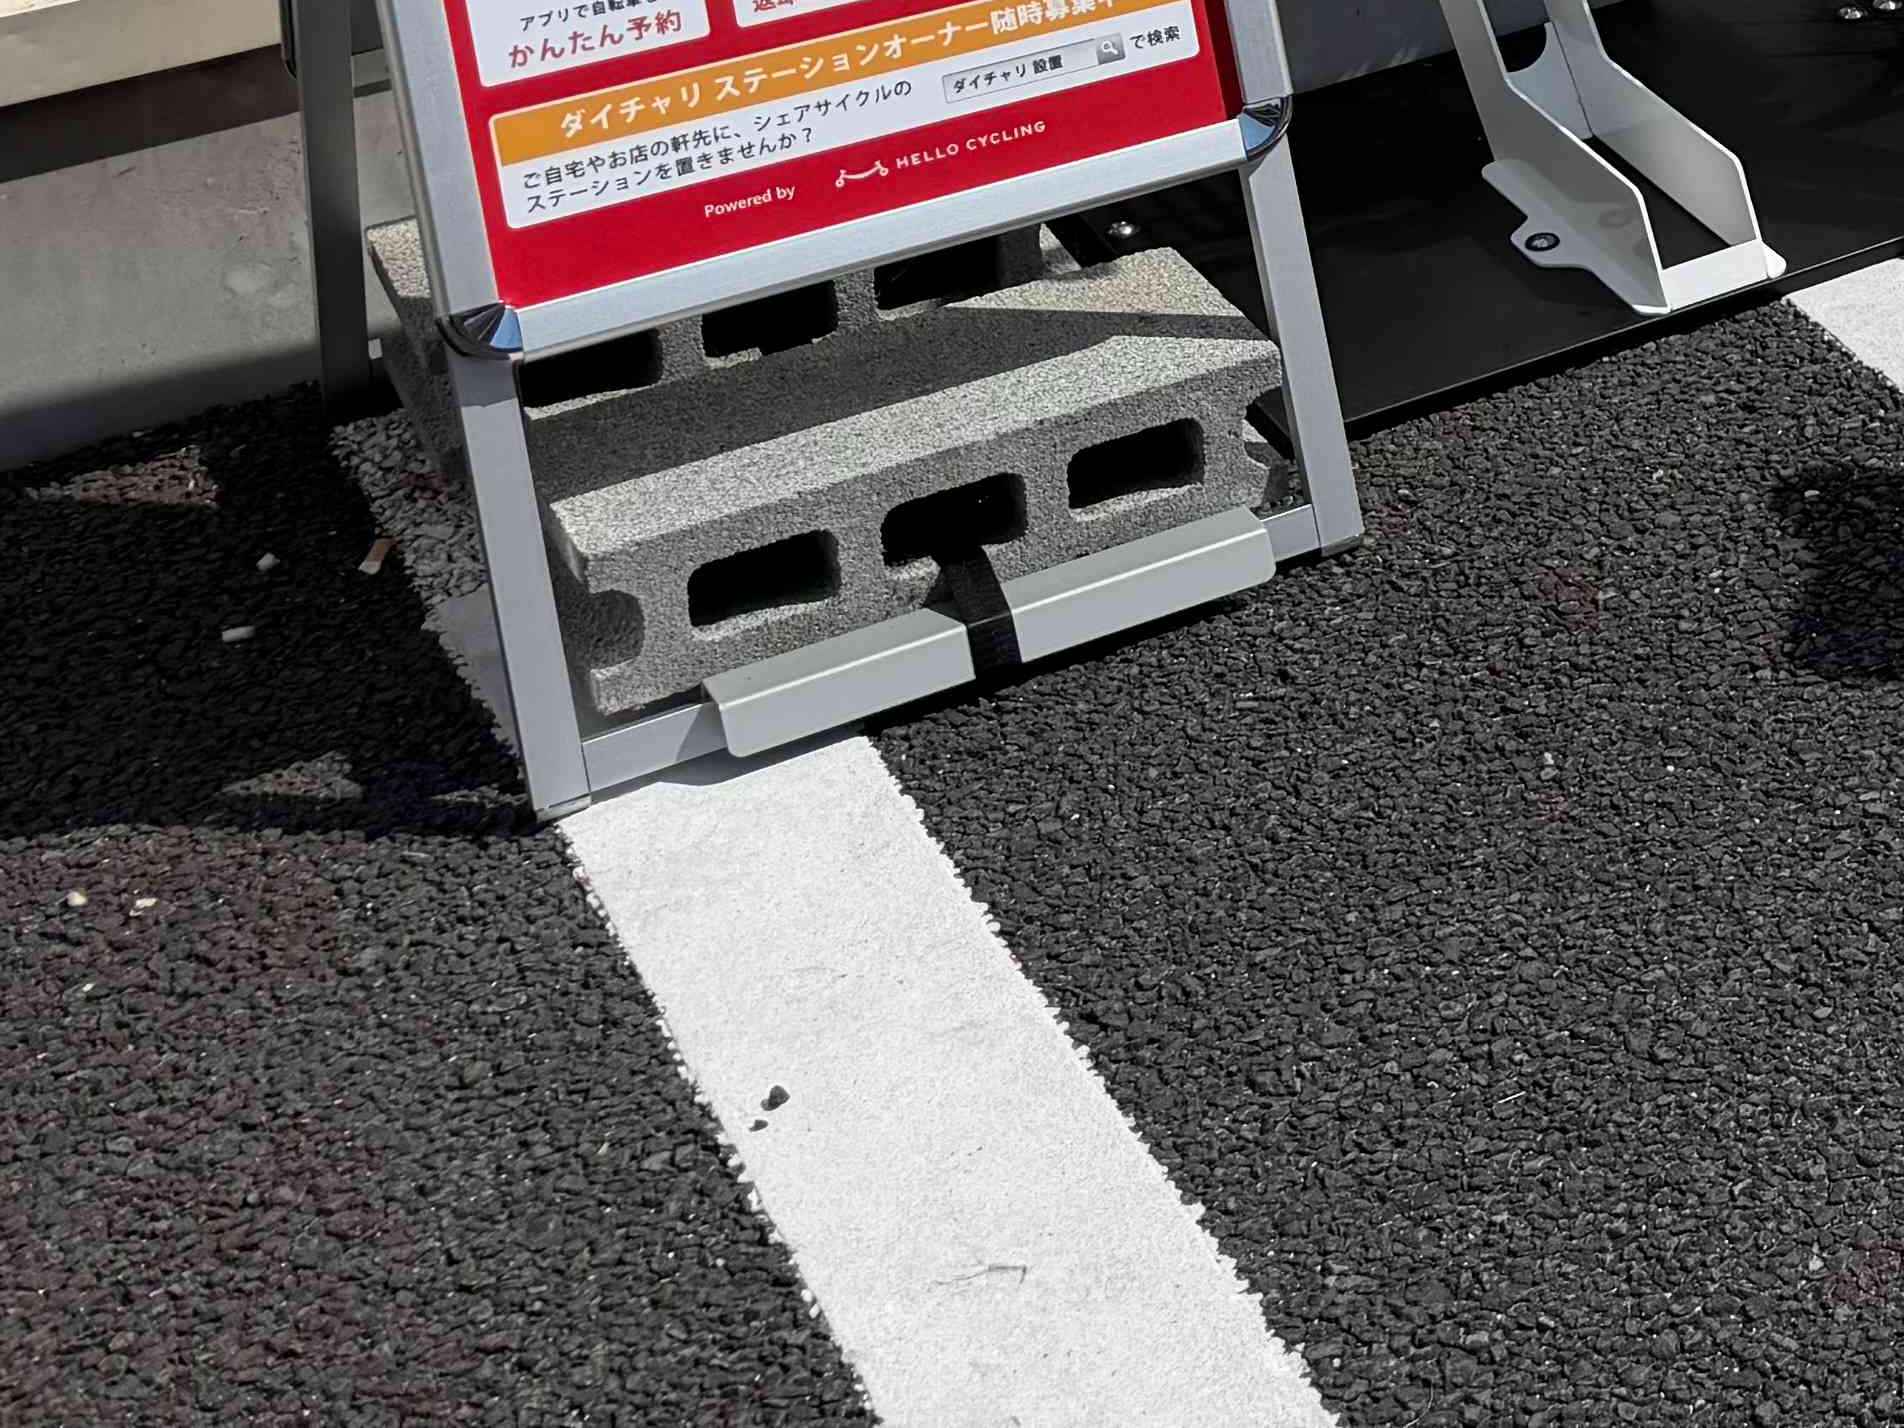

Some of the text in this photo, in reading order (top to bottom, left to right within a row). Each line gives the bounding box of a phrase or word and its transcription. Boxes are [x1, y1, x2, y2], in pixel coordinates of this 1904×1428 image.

[508, 9, 682, 69] かんたん予約
[1129, 25, 1182, 51] で検索
[952, 54, 1064, 95] ダイチャリ 設置
[560, 76, 702, 138] ダイチャリ
[523, 78, 912, 190] ご自宅やお店の軒先に、シェアサイクルの
[896, 119, 1047, 170] HELLO CYCLING
[703, 183, 796, 219] Powered by
